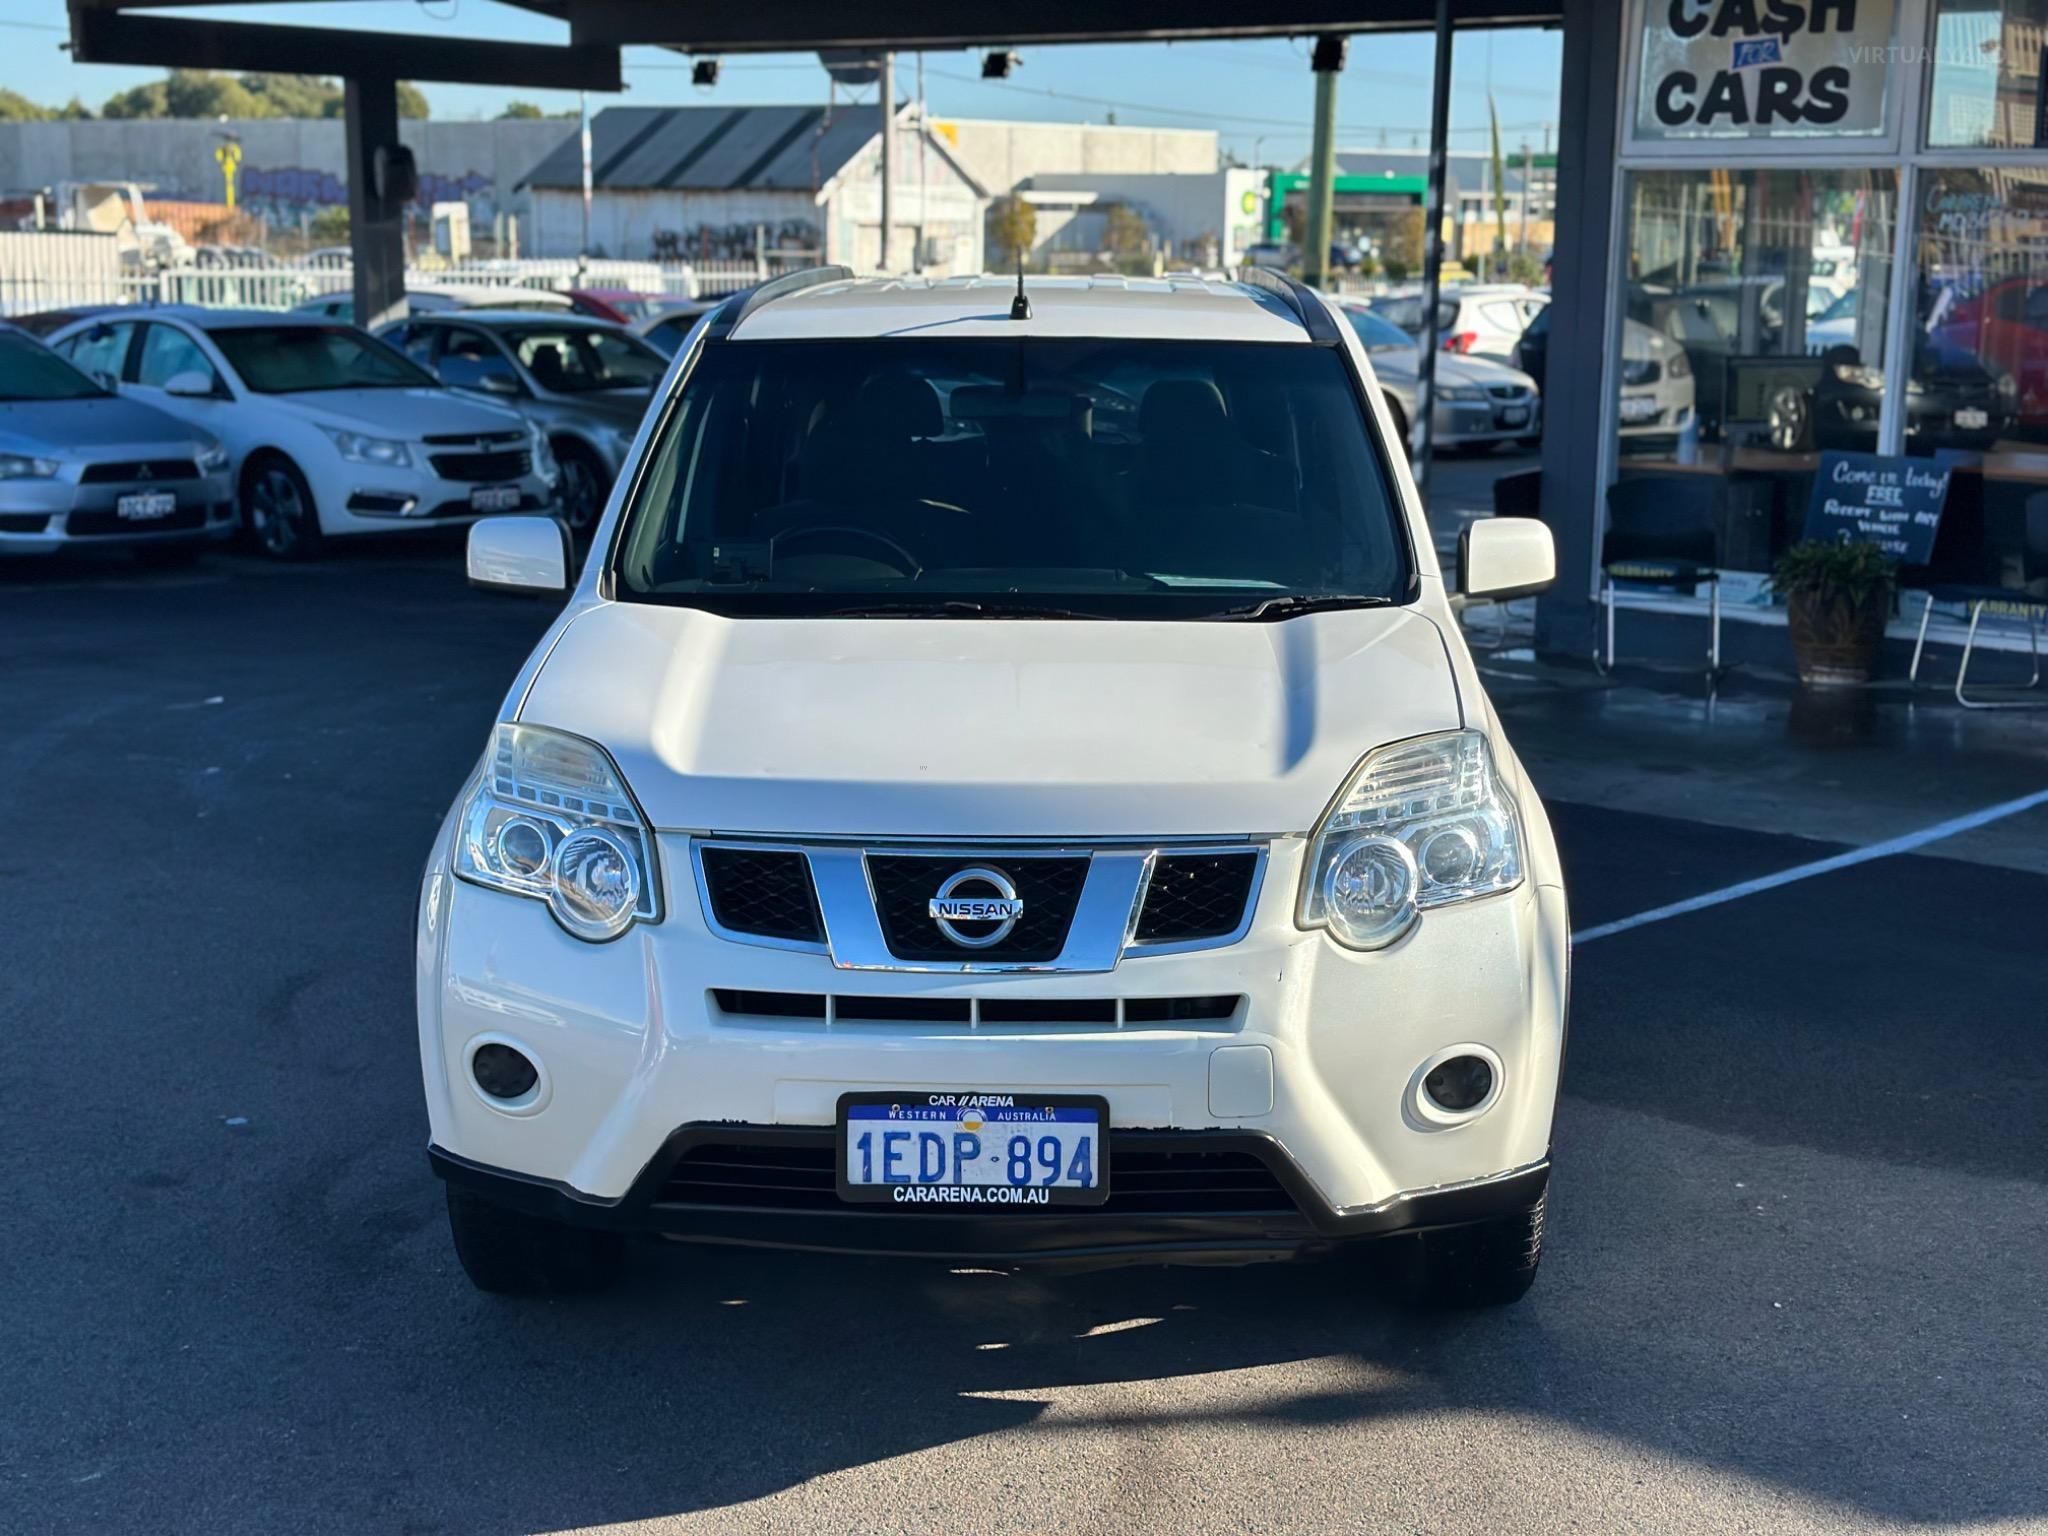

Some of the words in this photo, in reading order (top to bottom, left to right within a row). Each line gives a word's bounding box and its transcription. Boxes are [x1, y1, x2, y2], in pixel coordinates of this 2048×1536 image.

[1668, 0, 1857, 43] CASH
[1655, 66, 1851, 126] CARS
[1866, 485, 1904, 507] FREE
[939, 903, 1013, 915] NISSAN
[929, 1095, 956, 1107] CAR
[888, 1110, 947, 1120] WESTERN
[997, 1110, 1057, 1121] AUSTRALIA
[856, 1132, 982, 1184] 1EDP
[1006, 1135, 1093, 1189] 894
[893, 1186, 1050, 1204] CARARENA.COM.AU
